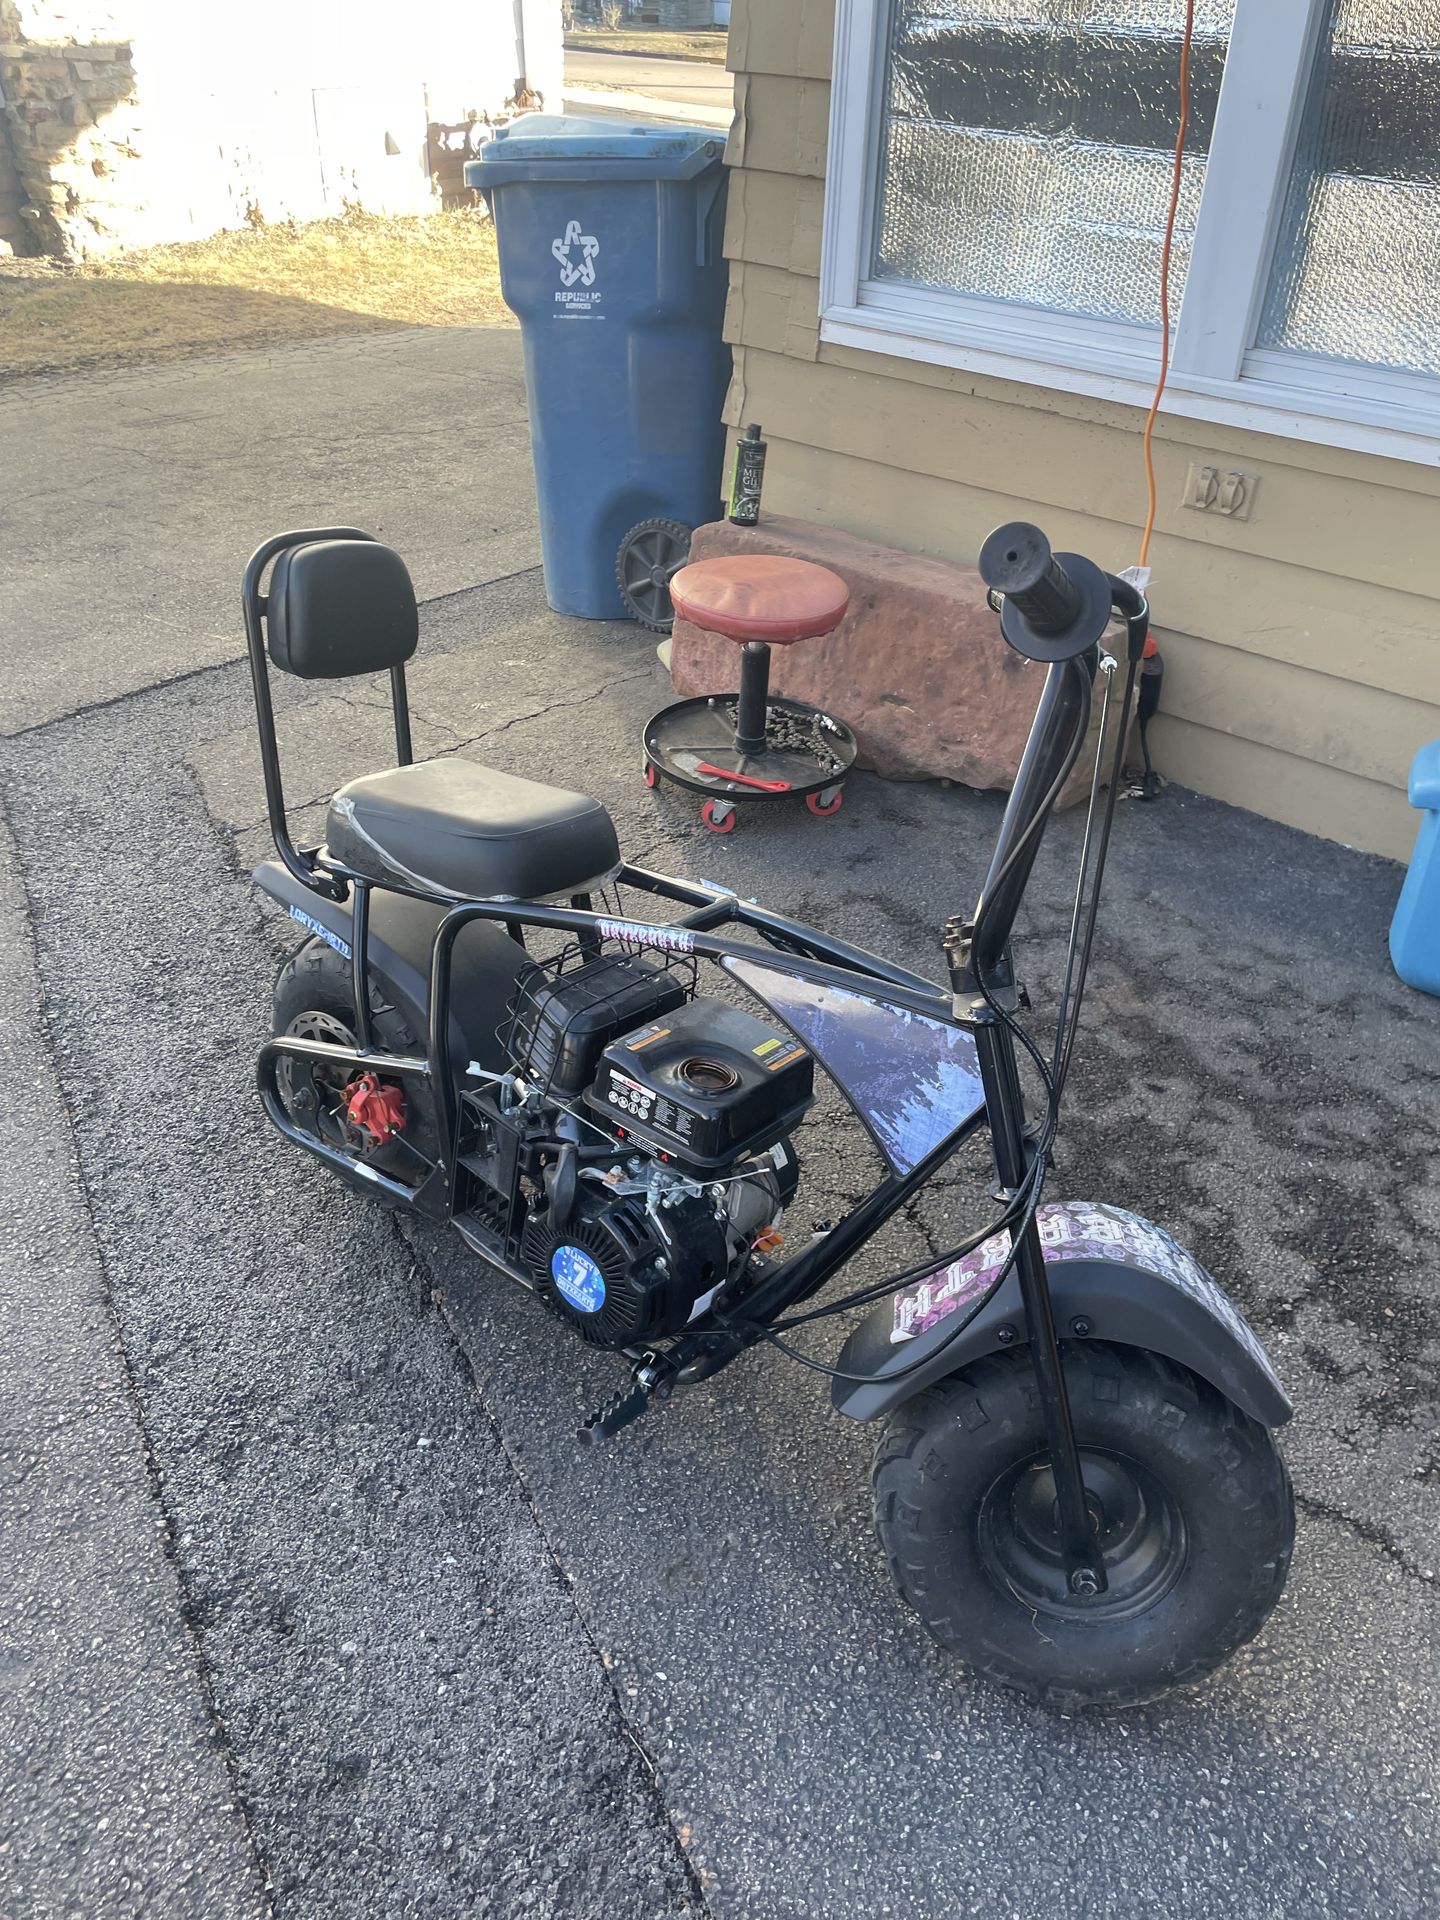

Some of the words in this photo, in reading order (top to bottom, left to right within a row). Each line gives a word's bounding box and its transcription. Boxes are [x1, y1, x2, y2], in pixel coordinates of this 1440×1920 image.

[555, 291, 602, 304] REPUBLIC
[570, 1250, 595, 1272] LUCKY
[572, 1261, 588, 1287] 7
